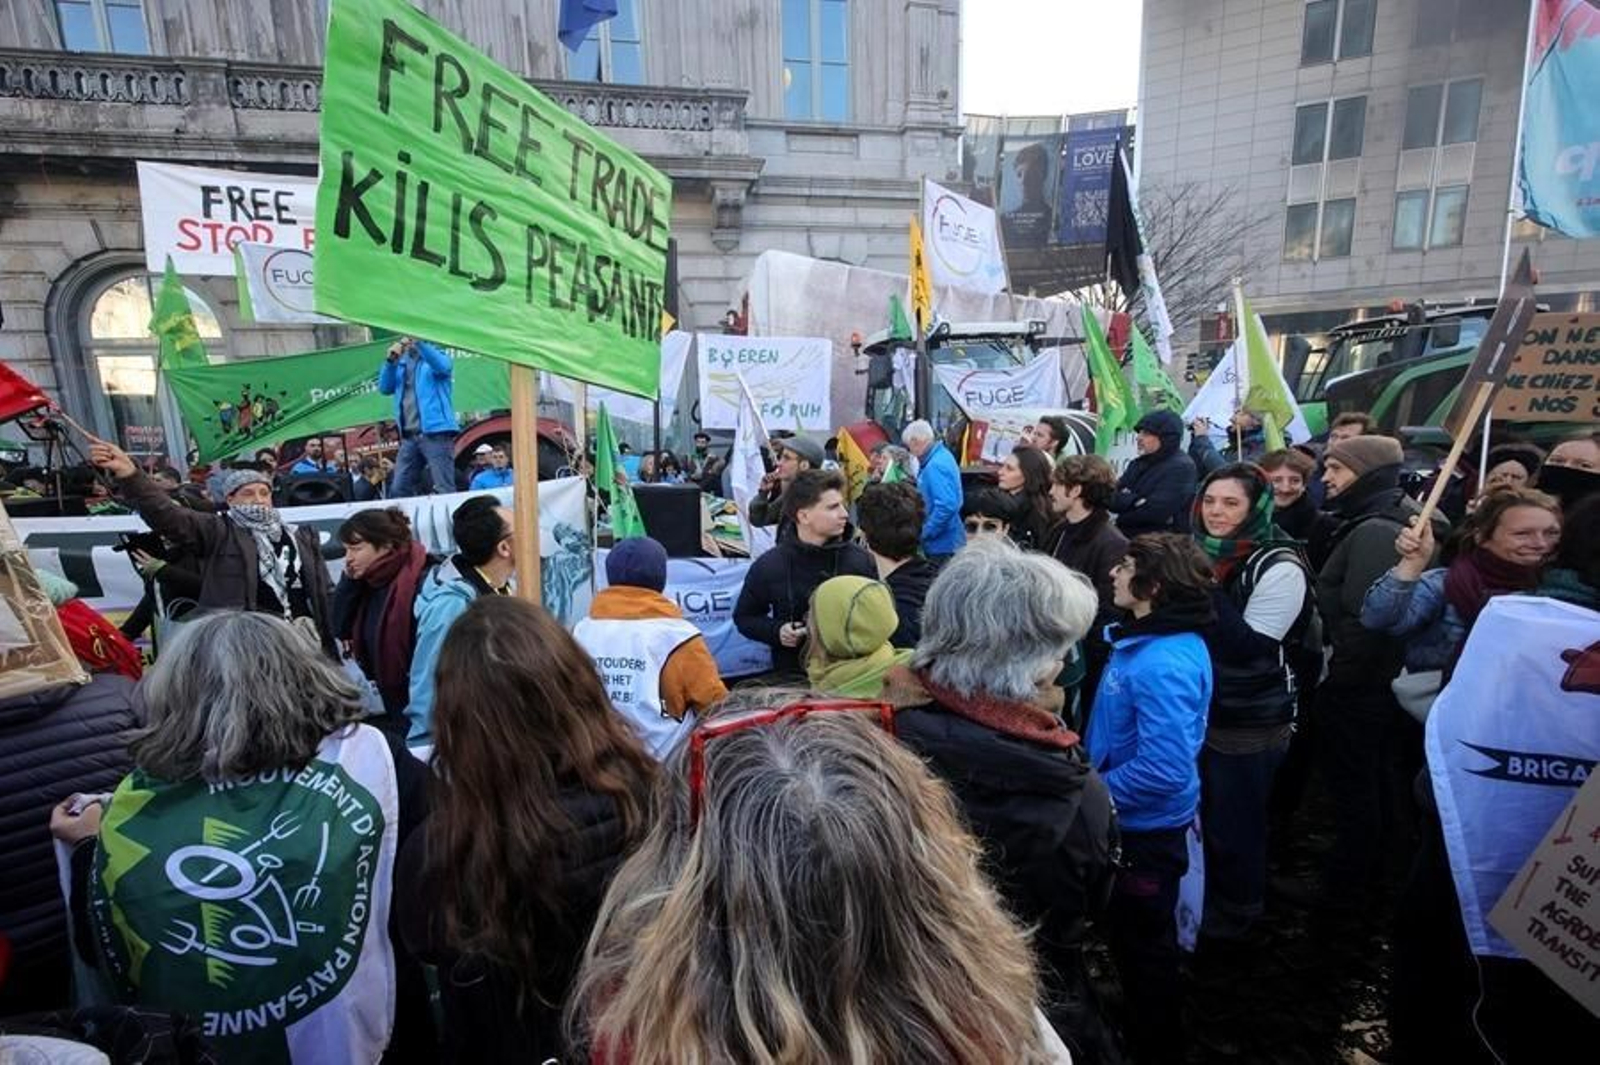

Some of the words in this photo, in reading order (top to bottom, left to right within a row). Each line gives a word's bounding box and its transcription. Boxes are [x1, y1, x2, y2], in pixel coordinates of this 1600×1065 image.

[378, 18, 555, 187] FREE
[563, 128, 669, 252] TRADE
[1073, 150, 1115, 169] LOVE
[201, 185, 297, 225] FREE
[965, 385, 1025, 407] FUGE
[1555, 876, 1591, 908] THE
[203, 947, 352, 1036] PAYSANNE
